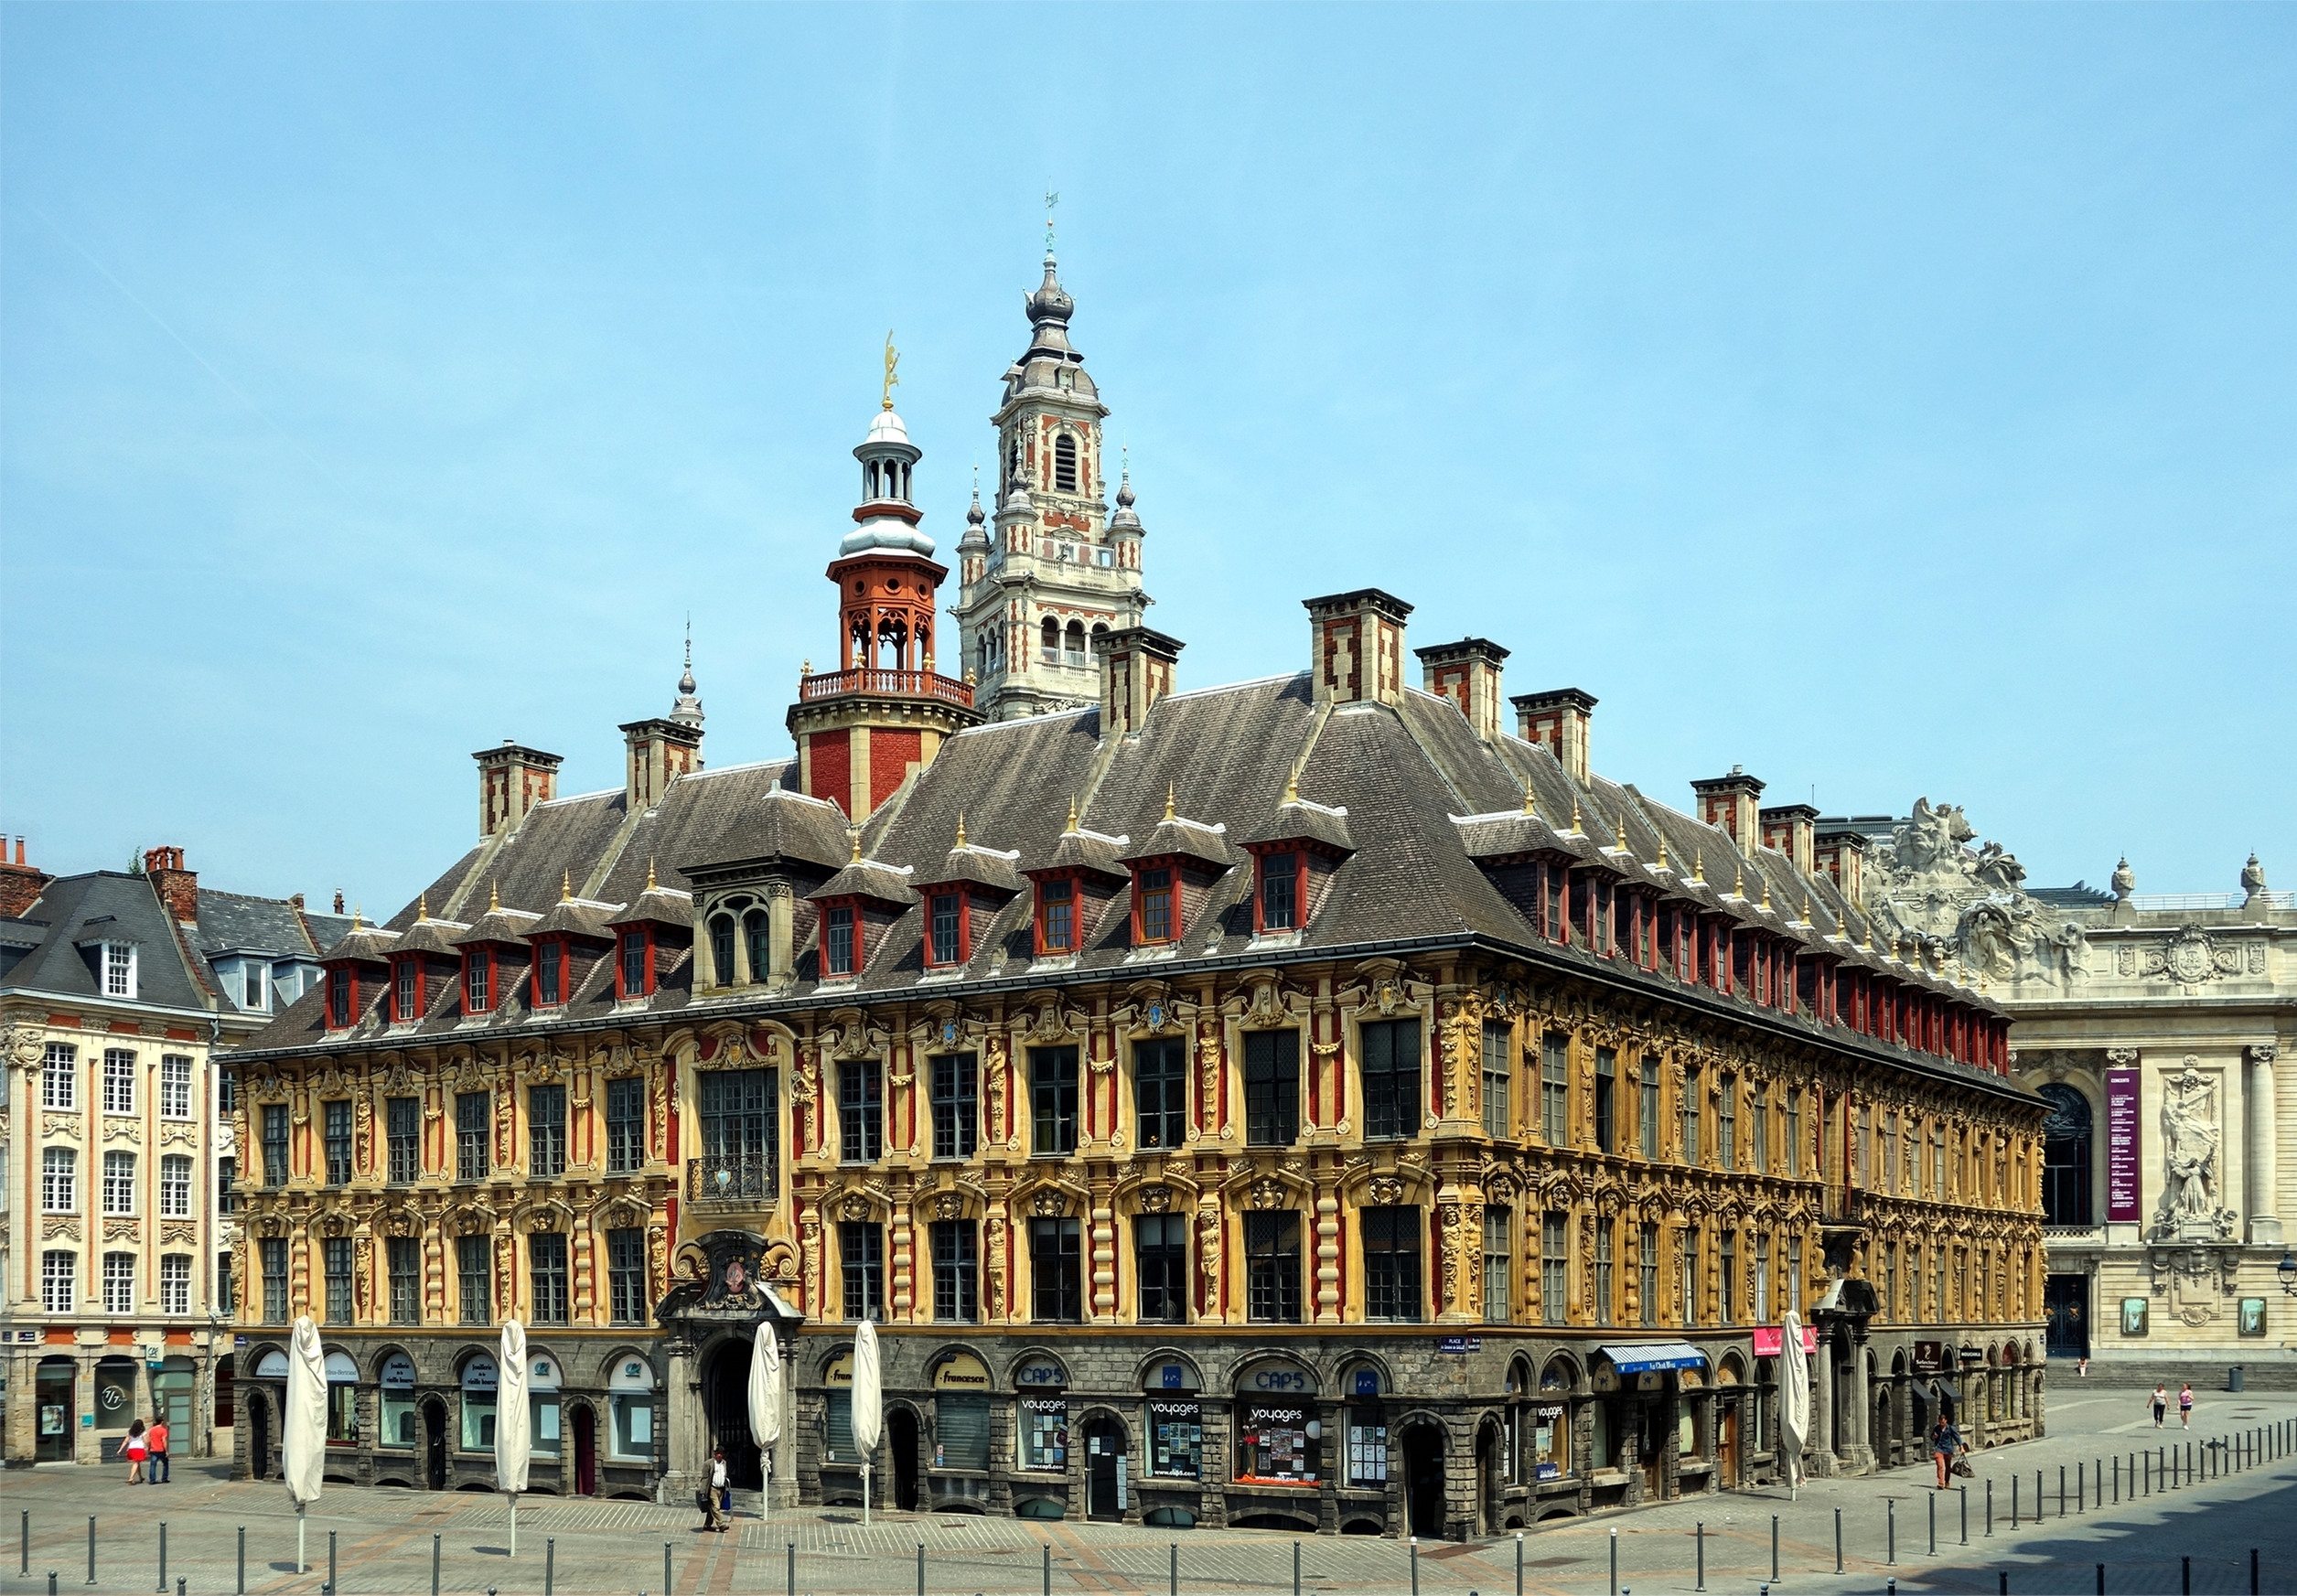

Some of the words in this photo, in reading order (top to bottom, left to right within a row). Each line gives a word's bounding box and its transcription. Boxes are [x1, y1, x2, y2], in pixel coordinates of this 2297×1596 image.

[943, 1371, 984, 1383] francesca
[1022, 1399, 1066, 1412] voyages
[1151, 1403, 1198, 1417] voyages
[1251, 1409, 1302, 1422] voyages
[1538, 1406, 1562, 1419] voyages
